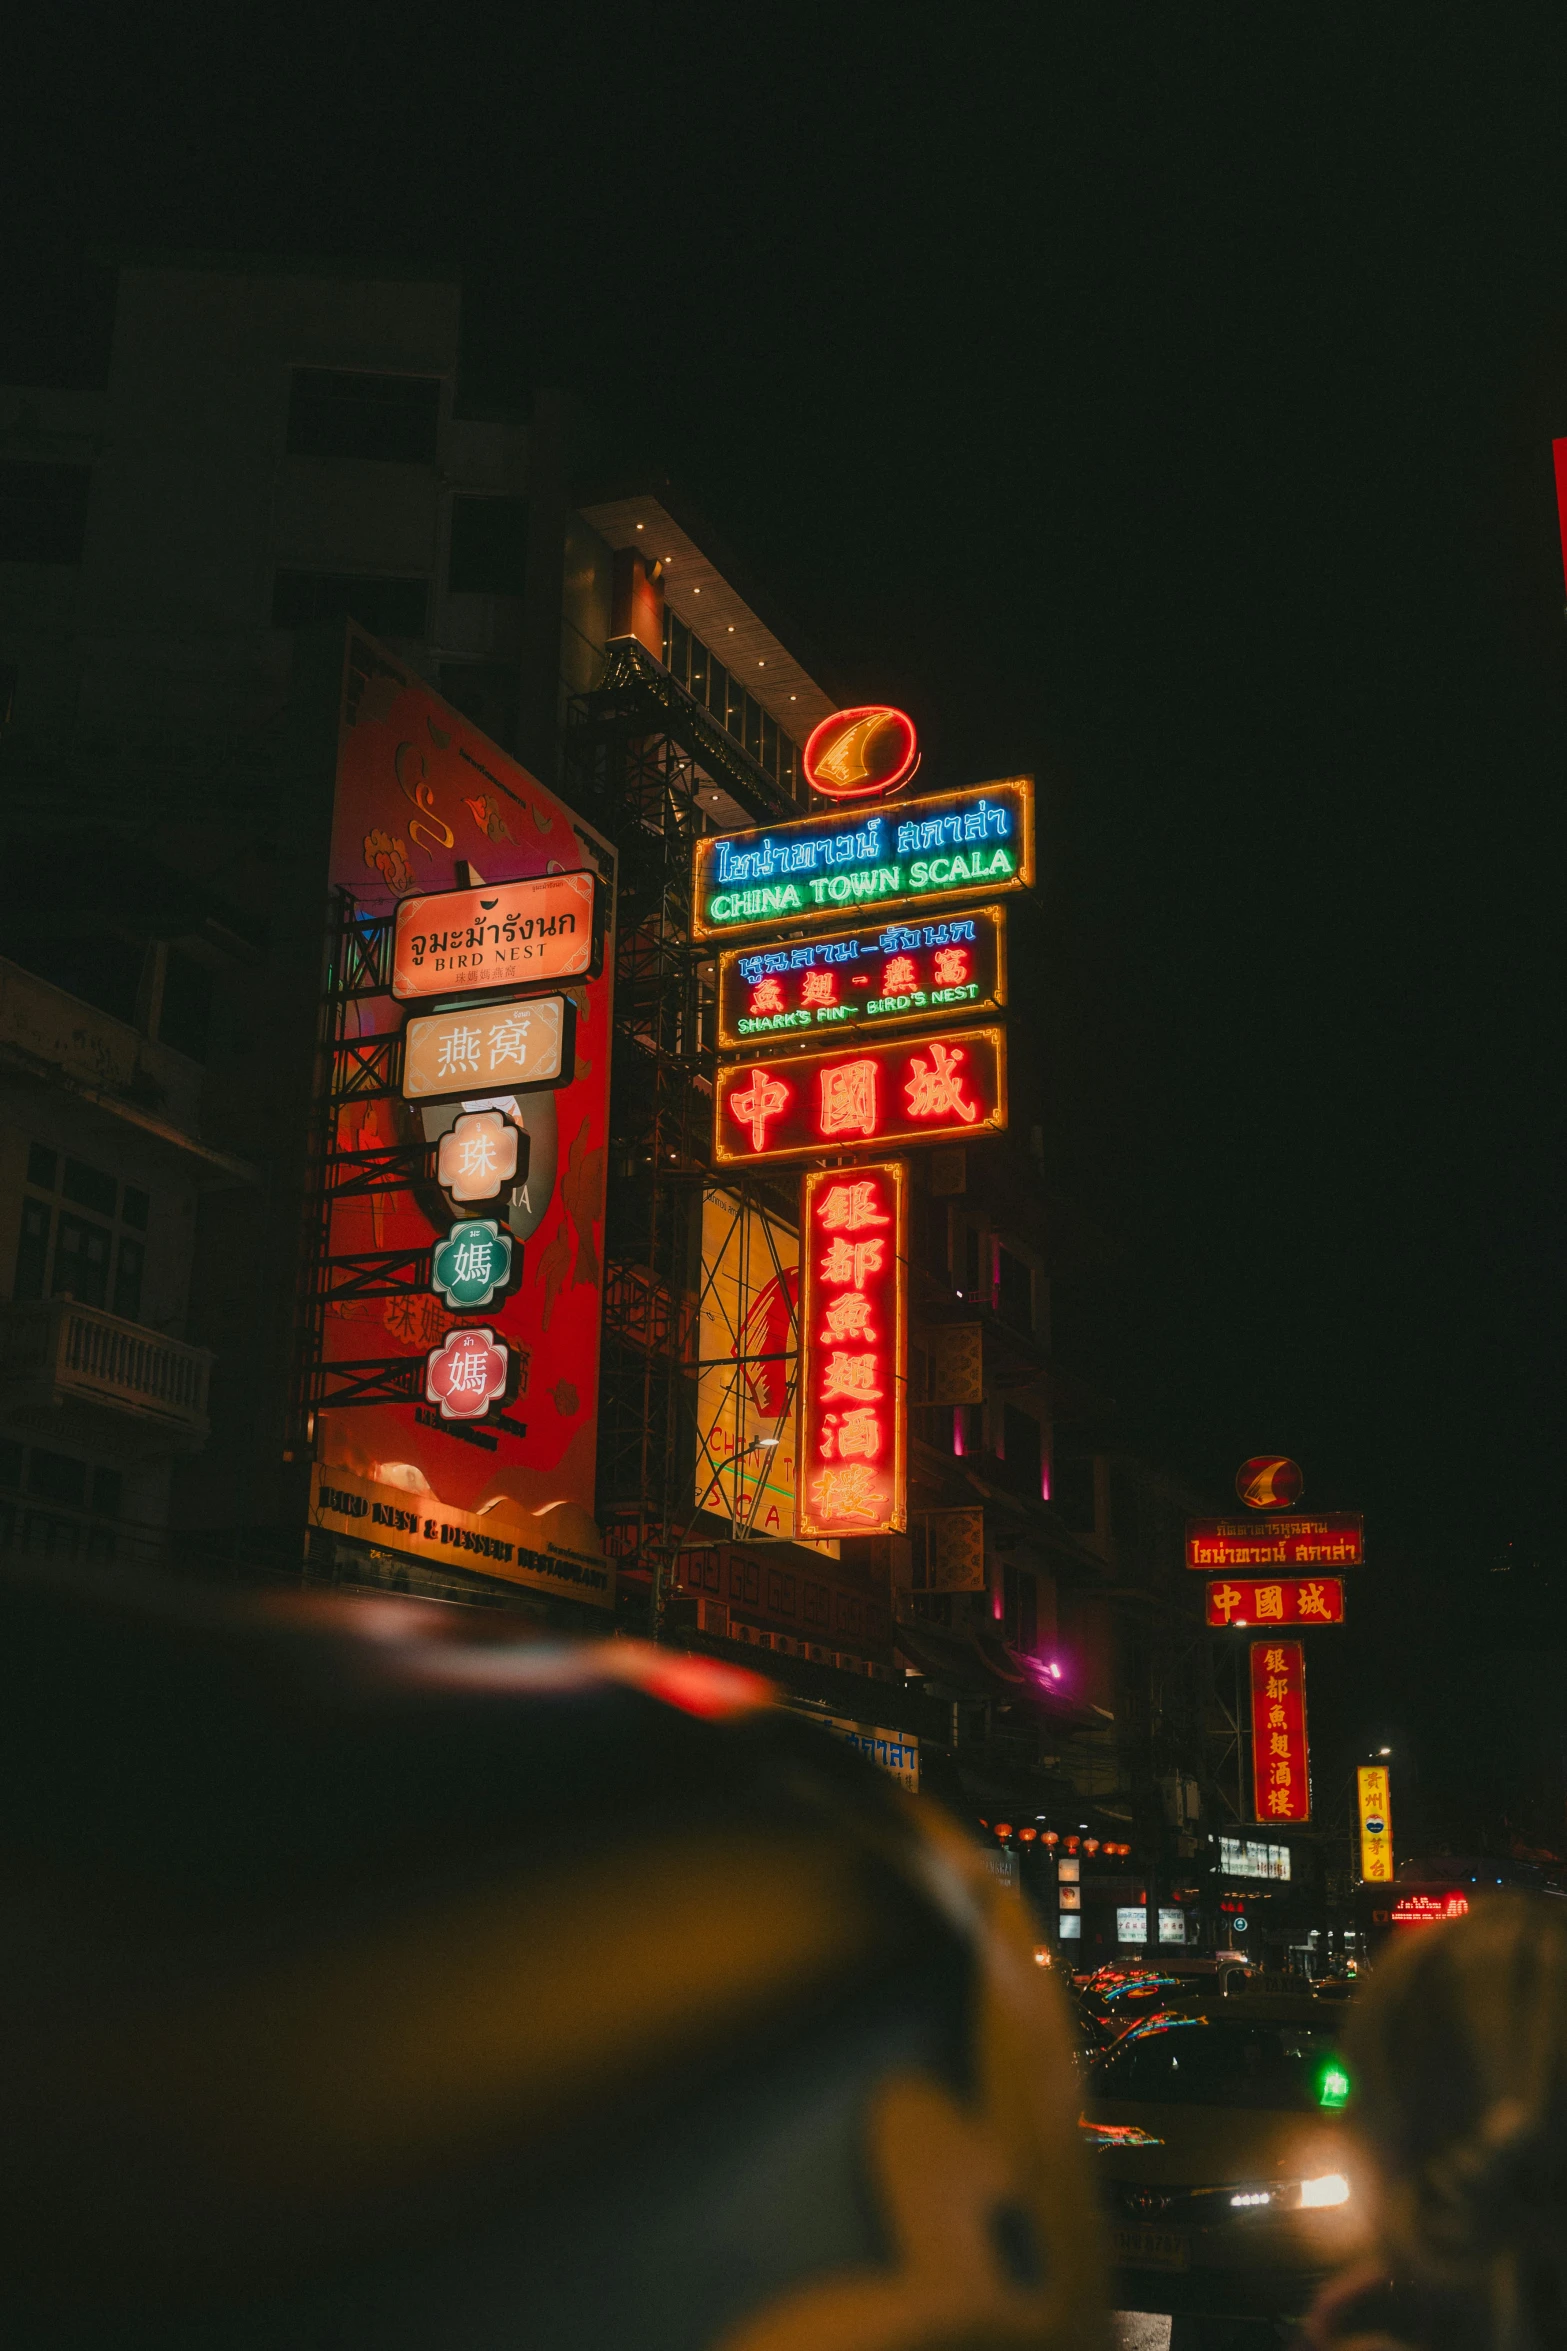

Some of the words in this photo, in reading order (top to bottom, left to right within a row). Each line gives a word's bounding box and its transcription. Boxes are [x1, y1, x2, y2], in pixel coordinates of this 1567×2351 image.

[716, 818, 881, 882] ไชน่าทาวน์
[711, 885, 801, 920] CHINA
[809, 866, 900, 904] TOWN
[909, 849, 1013, 888] SCALA
[411, 912, 576, 966] จูมะม้ารังนก
[435, 952, 483, 971] BIRD
[495, 943, 547, 963] NEST
[738, 1009, 812, 1035] SHARK'S
[867, 991, 927, 1015] BIRD'S
[932, 984, 979, 1005] NEST
[730, 1043, 976, 1152] 中國城
[458, 1134, 498, 1177] 珠
[452, 1241, 494, 1287] 媽
[446, 1351, 489, 1396] 媽
[319, 1485, 370, 1518] BIRD
[372, 1502, 422, 1533] NEST
[424, 1519, 439, 1540] &
[441, 1523, 516, 1563] DESSERT
[1213, 1582, 1332, 1622] 中國城
